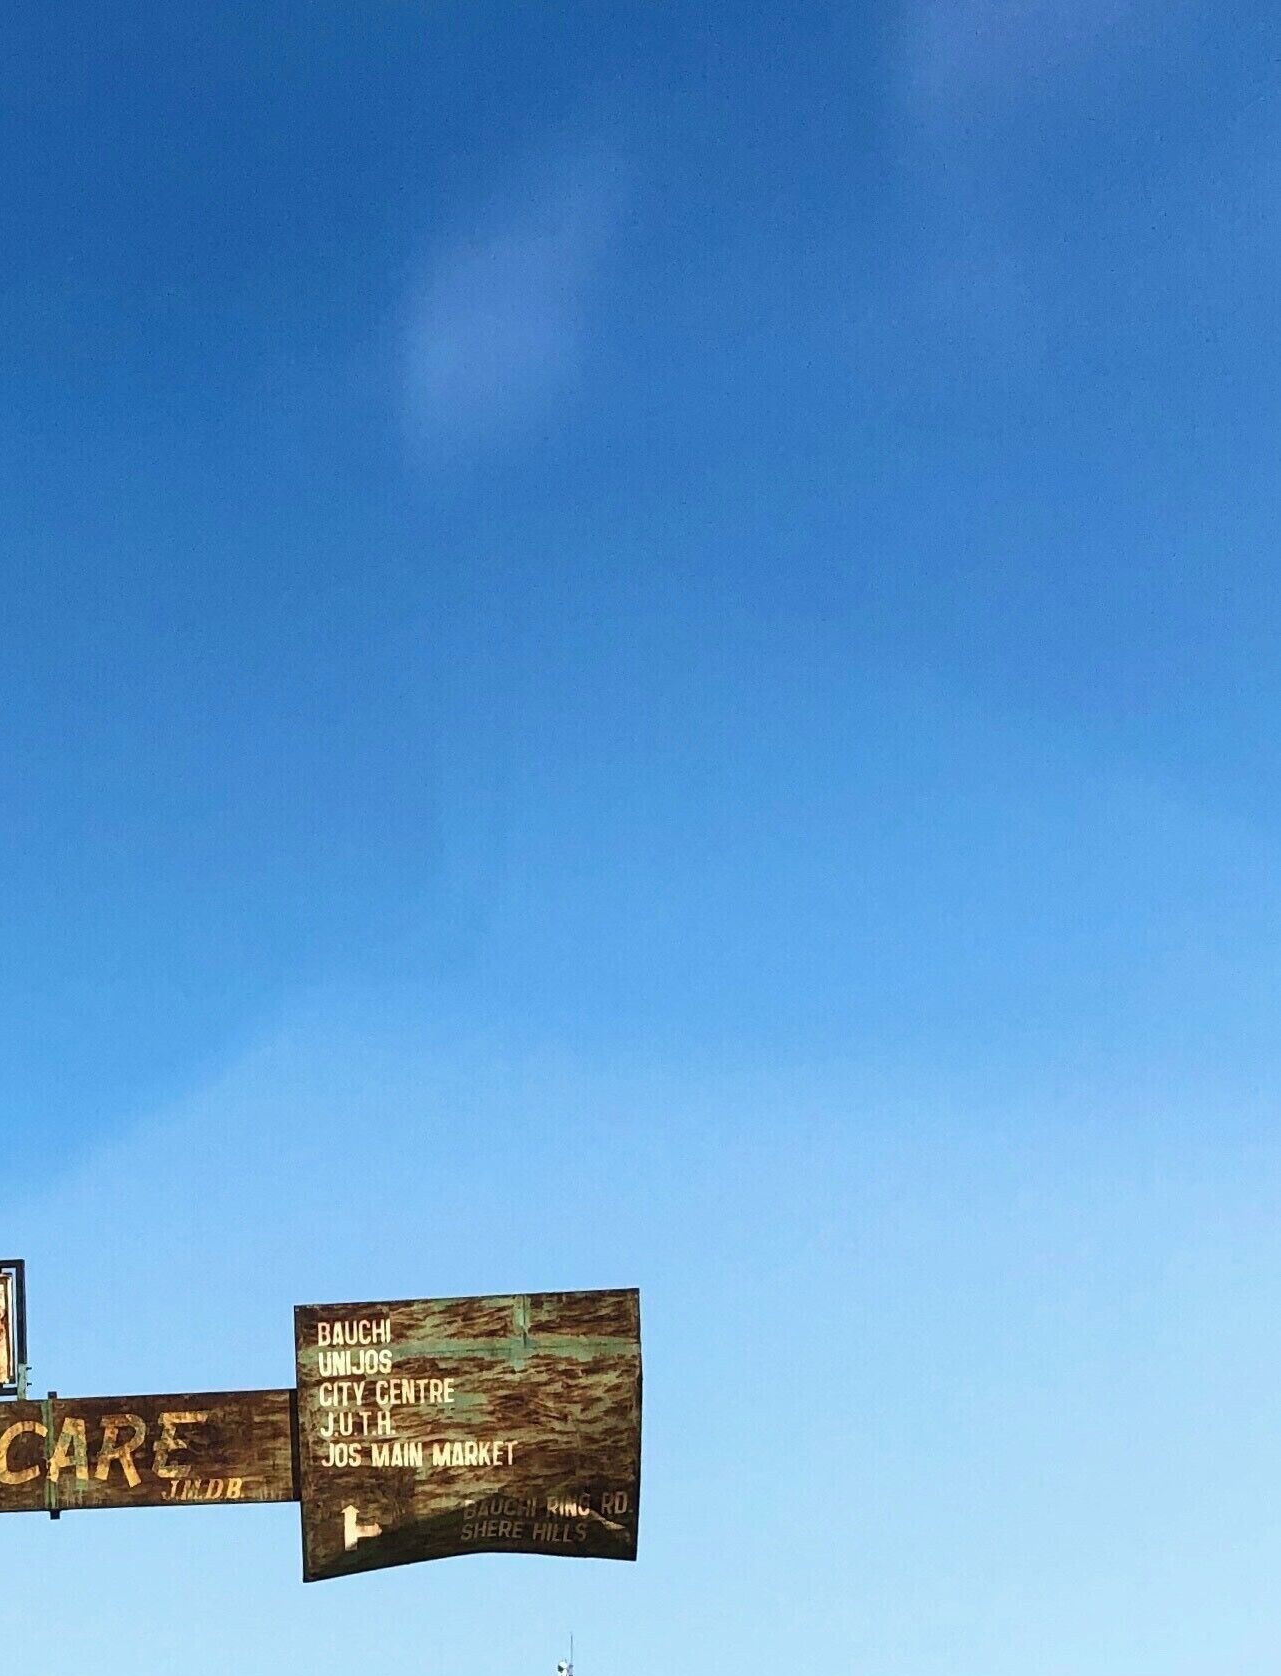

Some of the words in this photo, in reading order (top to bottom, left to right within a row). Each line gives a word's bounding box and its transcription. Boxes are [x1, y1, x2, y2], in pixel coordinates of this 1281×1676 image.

[318, 1319, 391, 1346] BAUCHI
[319, 1349, 393, 1377] UNIJOS
[320, 1381, 365, 1407] CITY
[376, 1378, 455, 1405] CENTRE
[322, 1443, 361, 1467] JOS
[371, 1442, 423, 1467] MAIN
[433, 1440, 518, 1466] MARKET
[463, 1497, 536, 1520] BAUCHI
[461, 1520, 522, 1540] SHERE
[533, 1522, 588, 1542] HILLS
